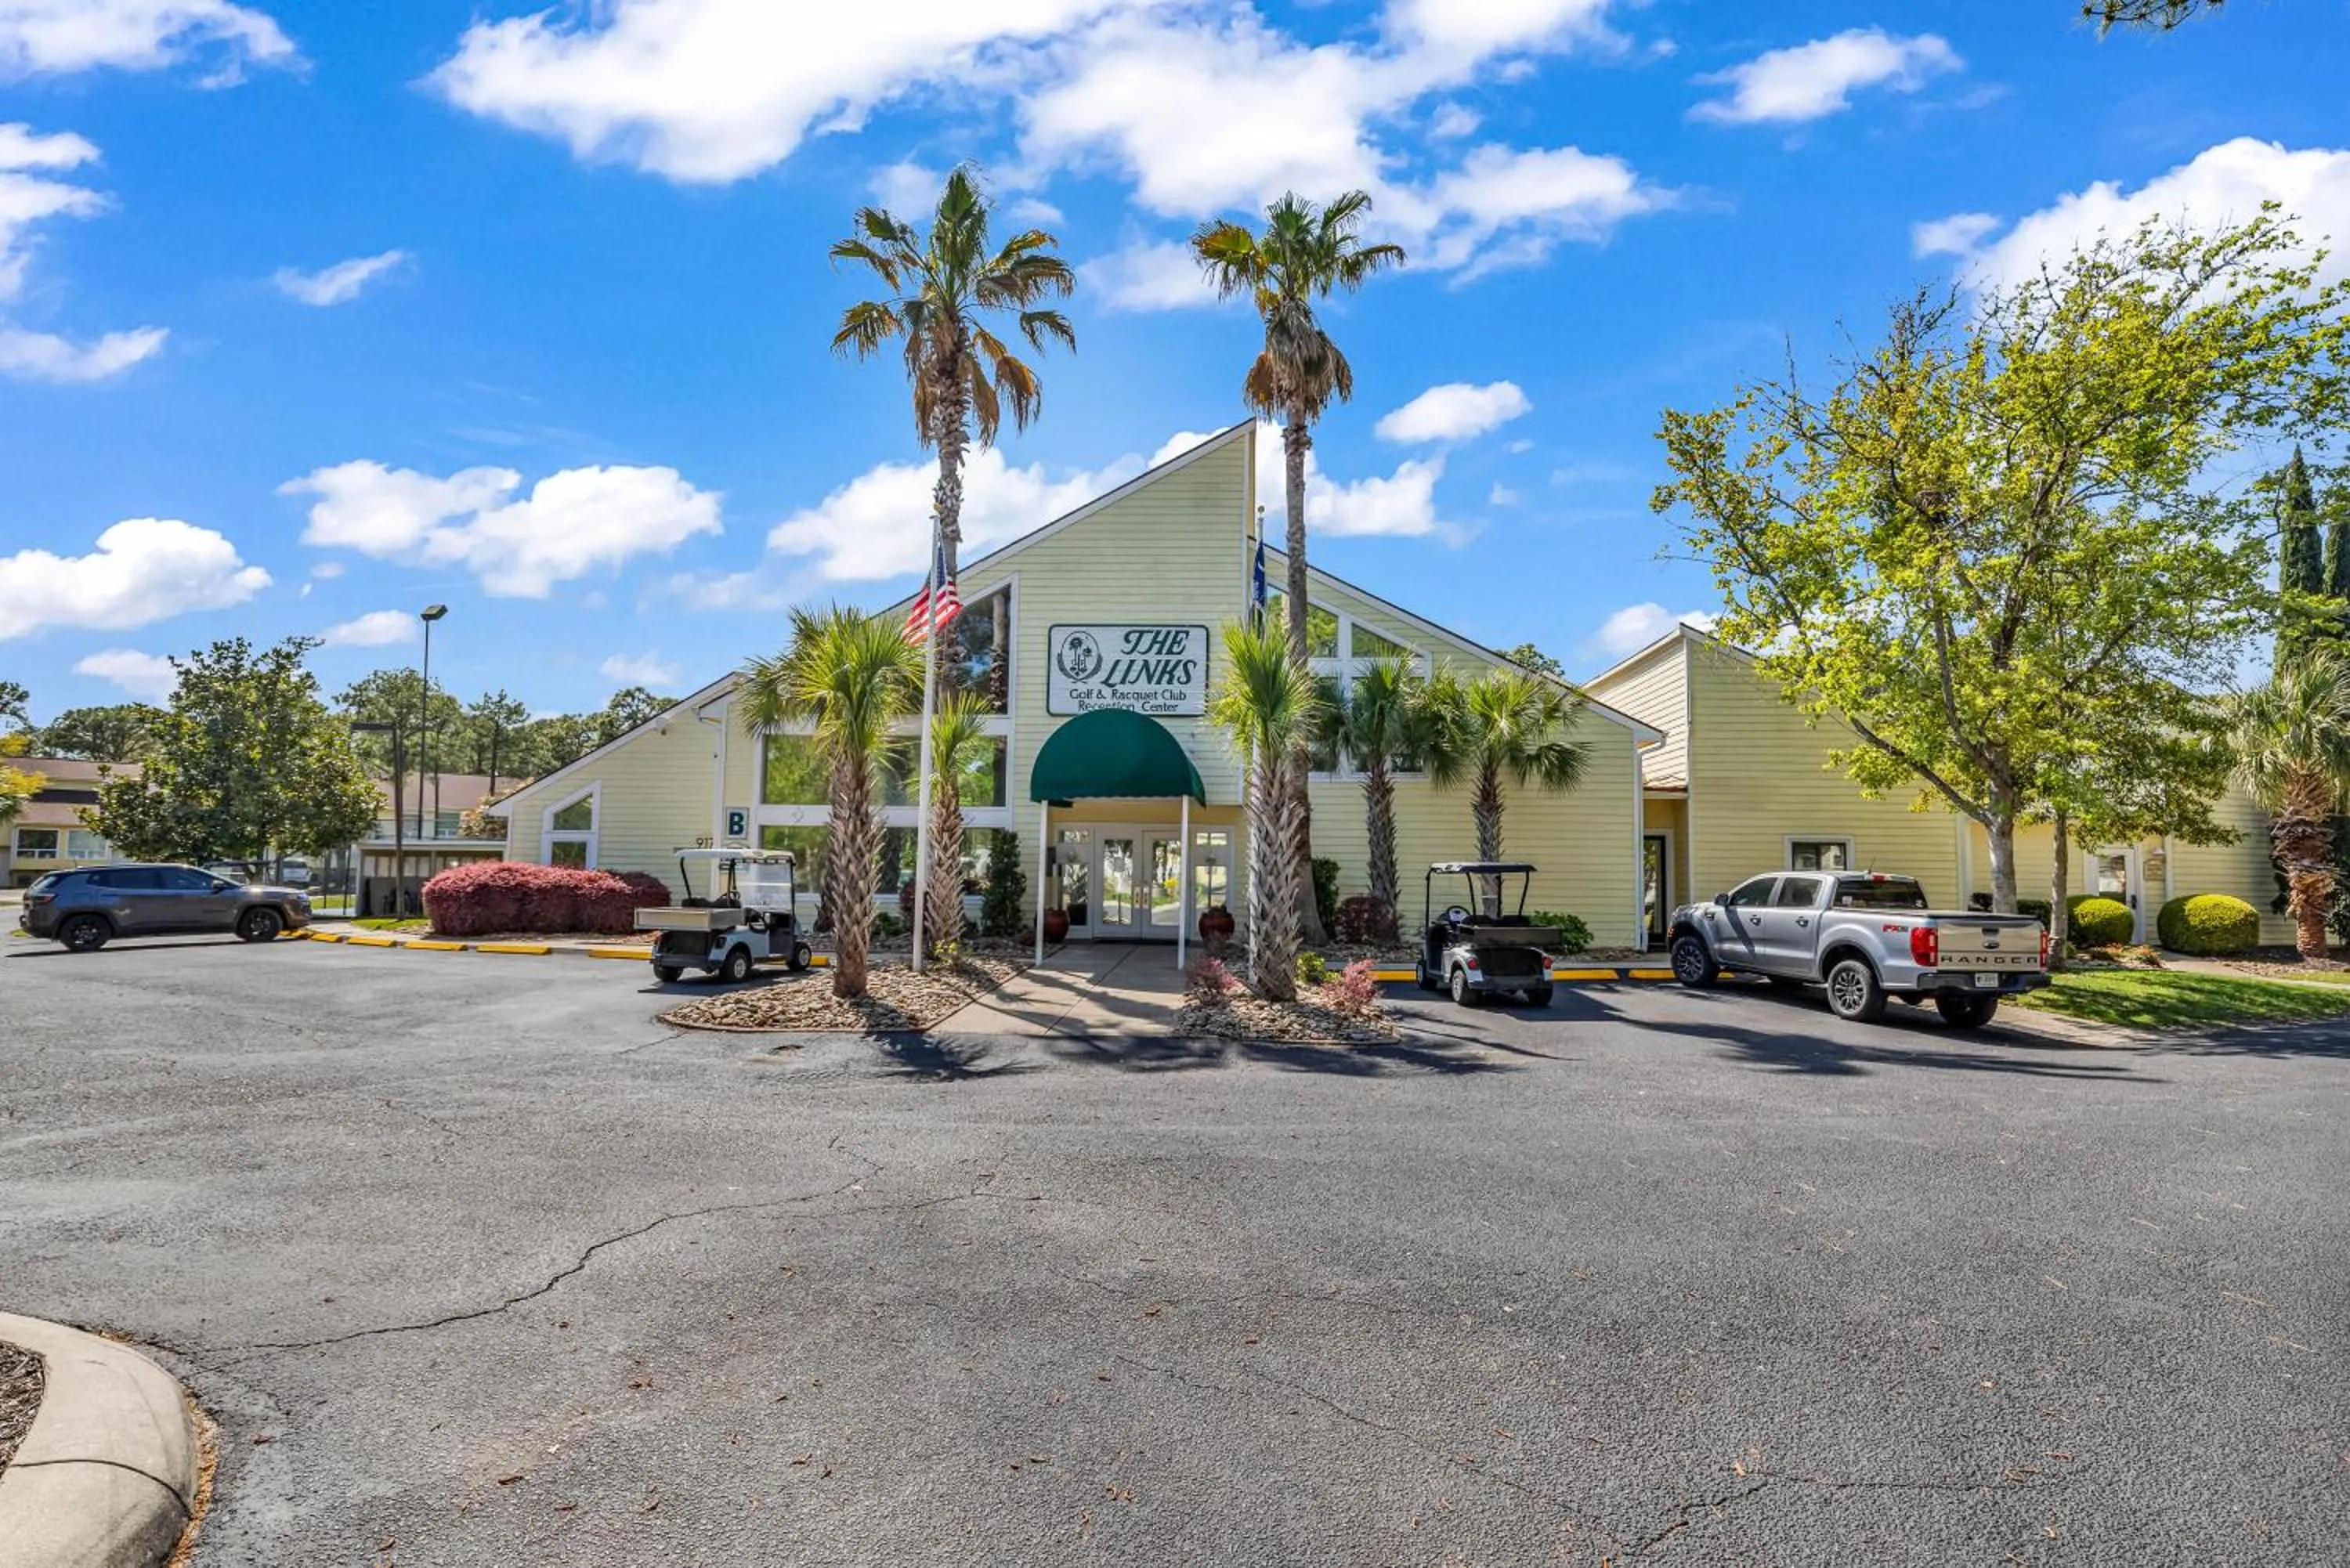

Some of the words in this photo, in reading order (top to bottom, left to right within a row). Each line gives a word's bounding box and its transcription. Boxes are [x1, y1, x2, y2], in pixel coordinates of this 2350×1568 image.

[1120, 630, 1190, 656] THE
[1100, 659, 1197, 688] LINKS
[1069, 688, 1094, 699] Golf
[1096, 688, 1106, 699] &
[1112, 688, 1159, 702] Racquet
[1162, 688, 1187, 701] Club
[1141, 701, 1179, 712] Center
[729, 811, 743, 835] B
[1940, 956, 2037, 964] RANGER
